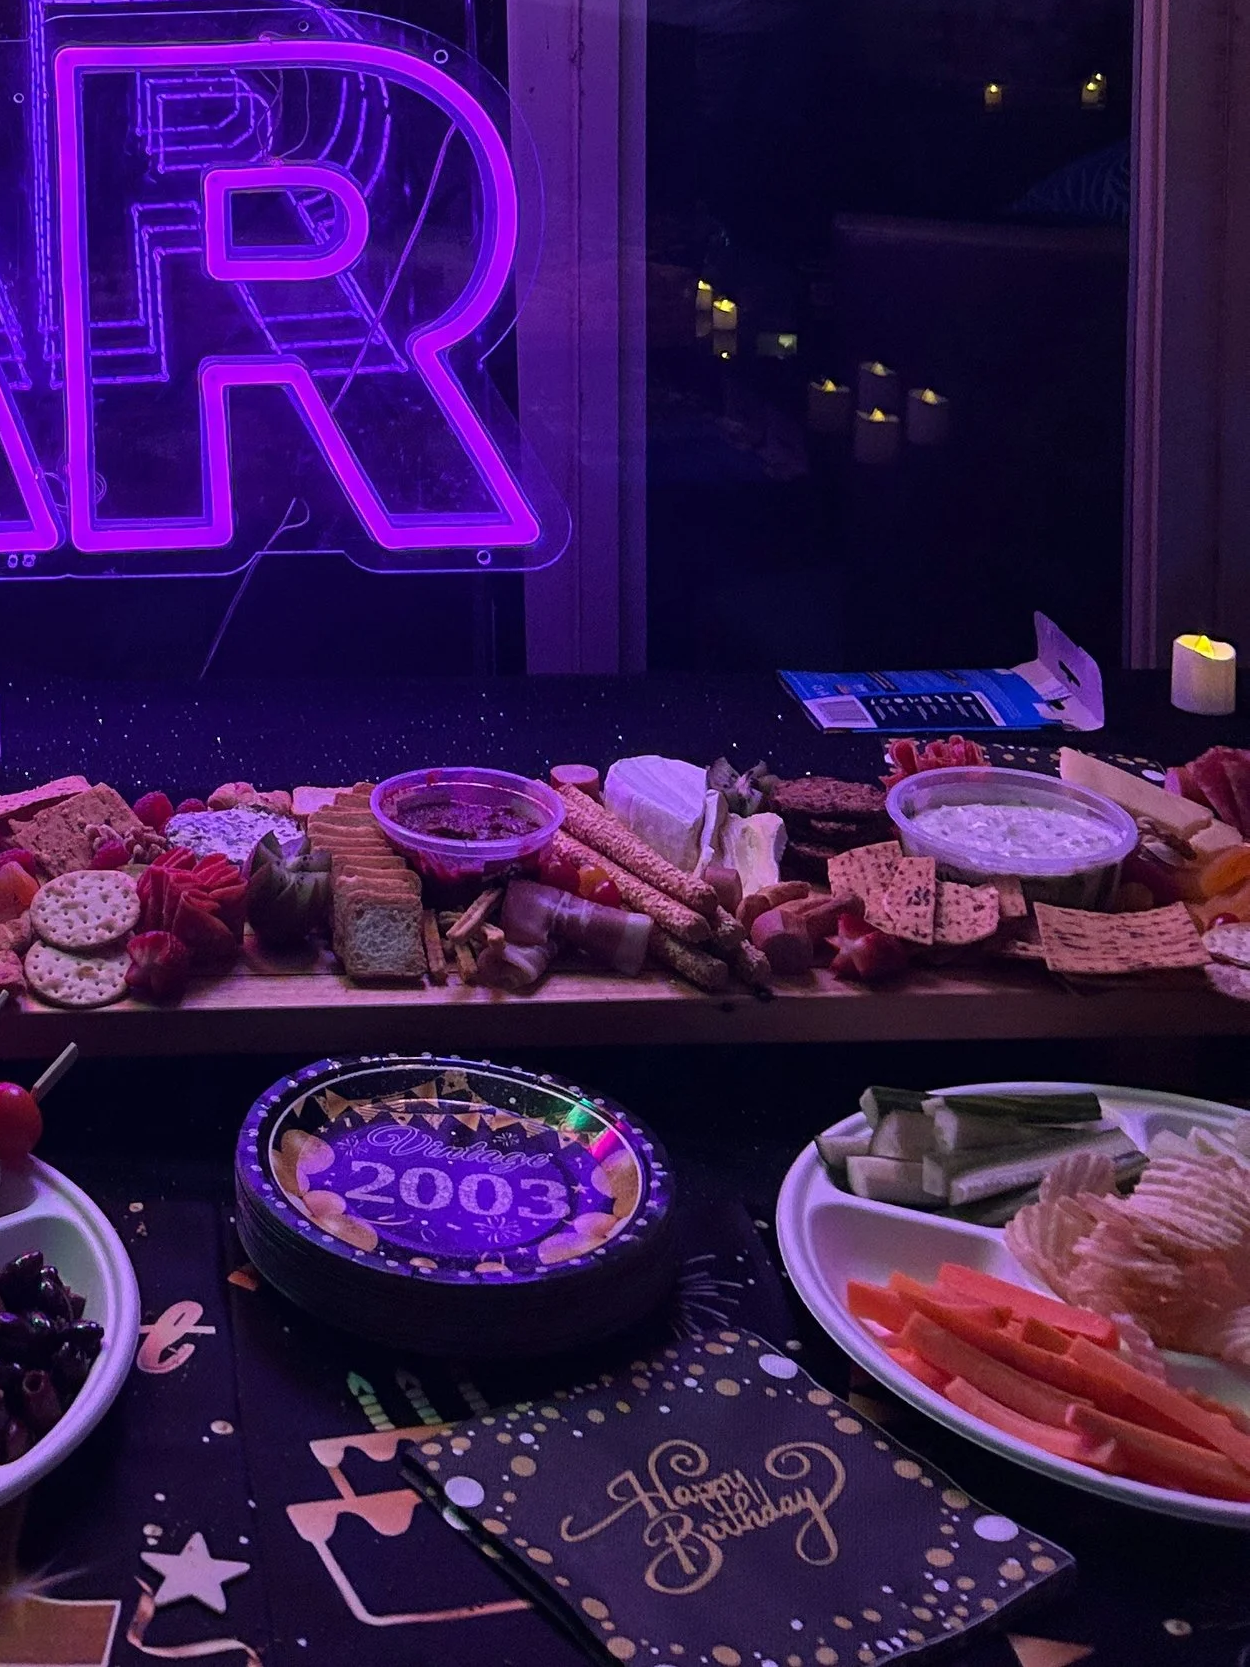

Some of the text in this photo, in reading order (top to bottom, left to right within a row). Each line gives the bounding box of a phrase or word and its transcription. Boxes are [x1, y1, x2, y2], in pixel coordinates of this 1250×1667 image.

[366, 1123, 551, 1174] Vintage
[344, 1159, 571, 1221] 2003
[560, 1439, 750, 1542] Happy
[644, 1441, 847, 1595] Birthday
